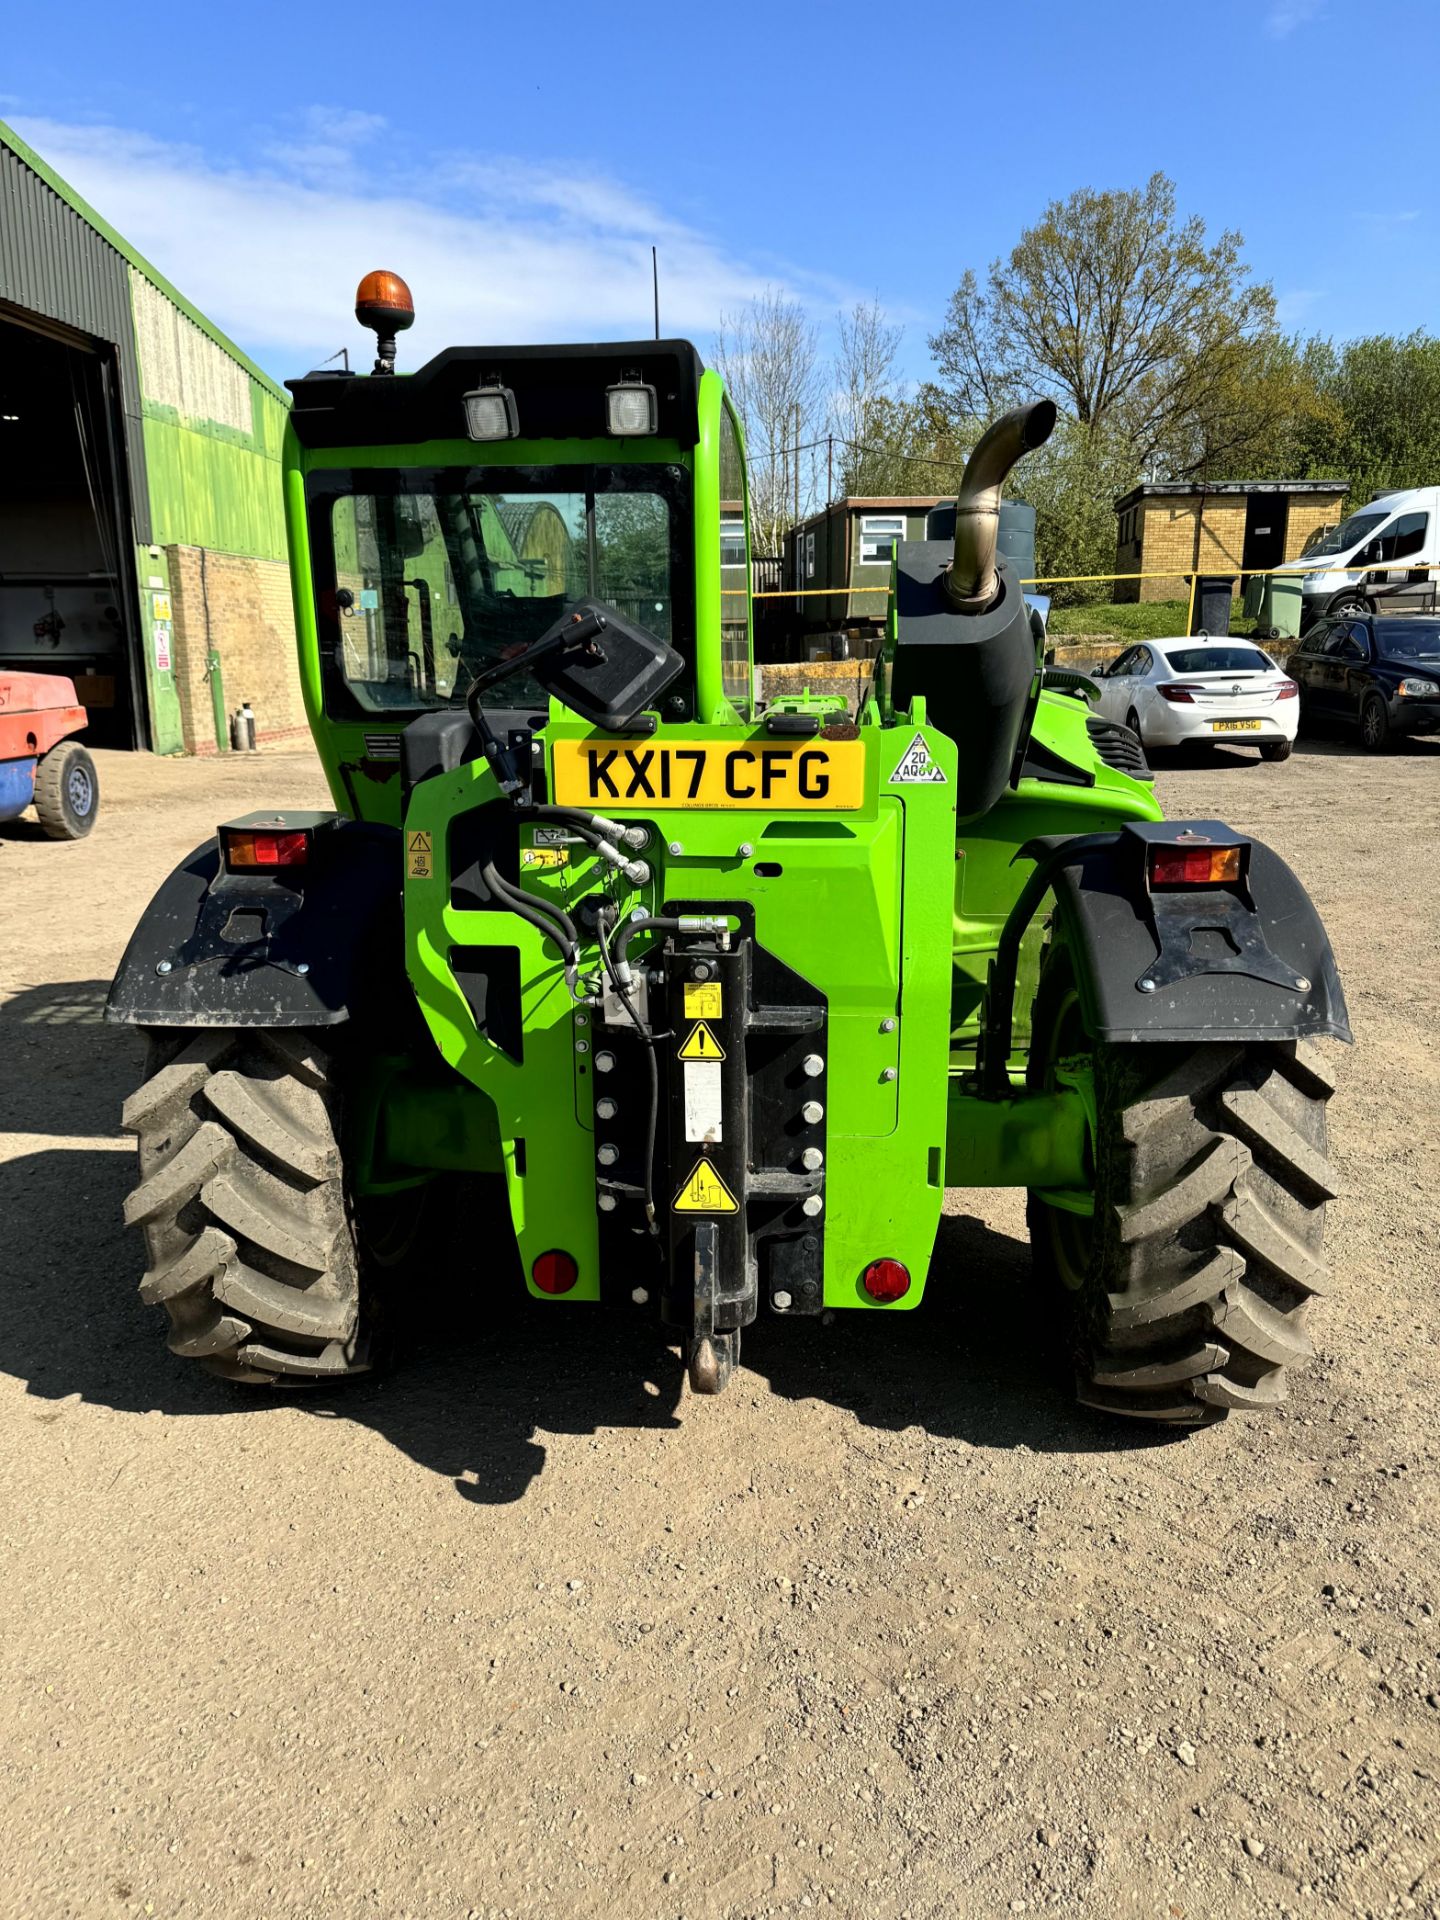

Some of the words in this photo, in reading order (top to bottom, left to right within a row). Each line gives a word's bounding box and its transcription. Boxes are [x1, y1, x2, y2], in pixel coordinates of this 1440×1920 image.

[1219, 720, 1238, 730] PX16
[1240, 719, 1257, 729] VSG
[911, 752, 926, 764] 20
[588, 750, 706, 798] KX17
[725, 750, 830, 799] CFG
